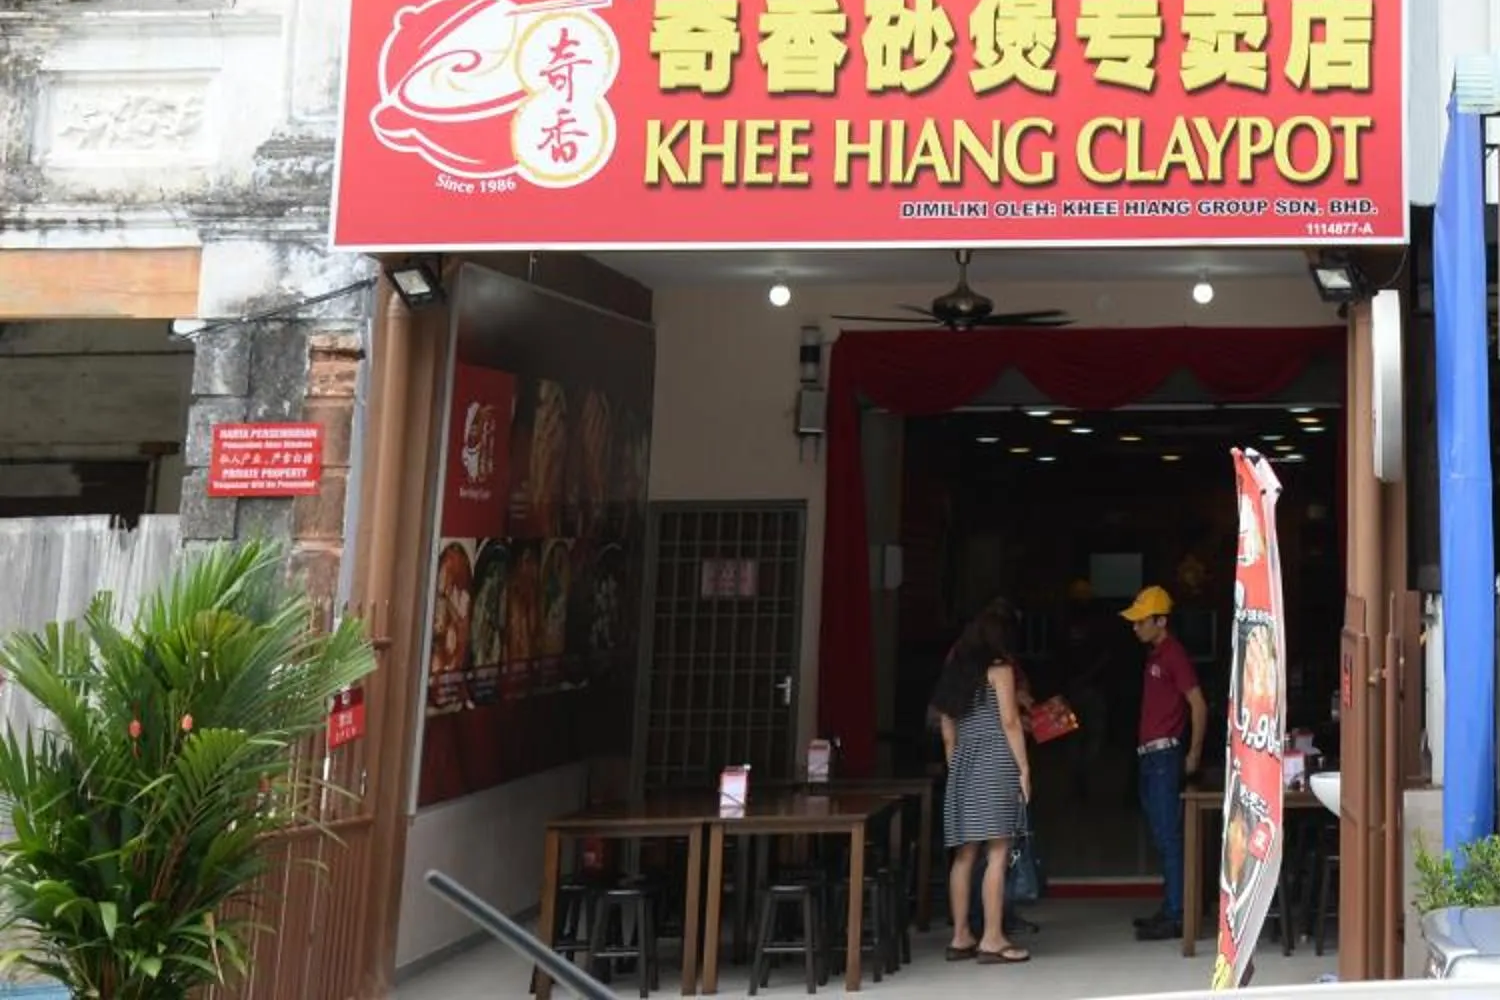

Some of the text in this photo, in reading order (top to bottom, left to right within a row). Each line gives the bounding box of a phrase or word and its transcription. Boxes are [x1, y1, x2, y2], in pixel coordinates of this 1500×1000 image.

[645, 116, 1372, 185] KHEE HIANG CLAYPOT
[435, 174, 517, 194] Since 1986
[901, 200, 1379, 218] DIMILIKI OLEH: KHEE HIANG GROUP SDN. BHD.
